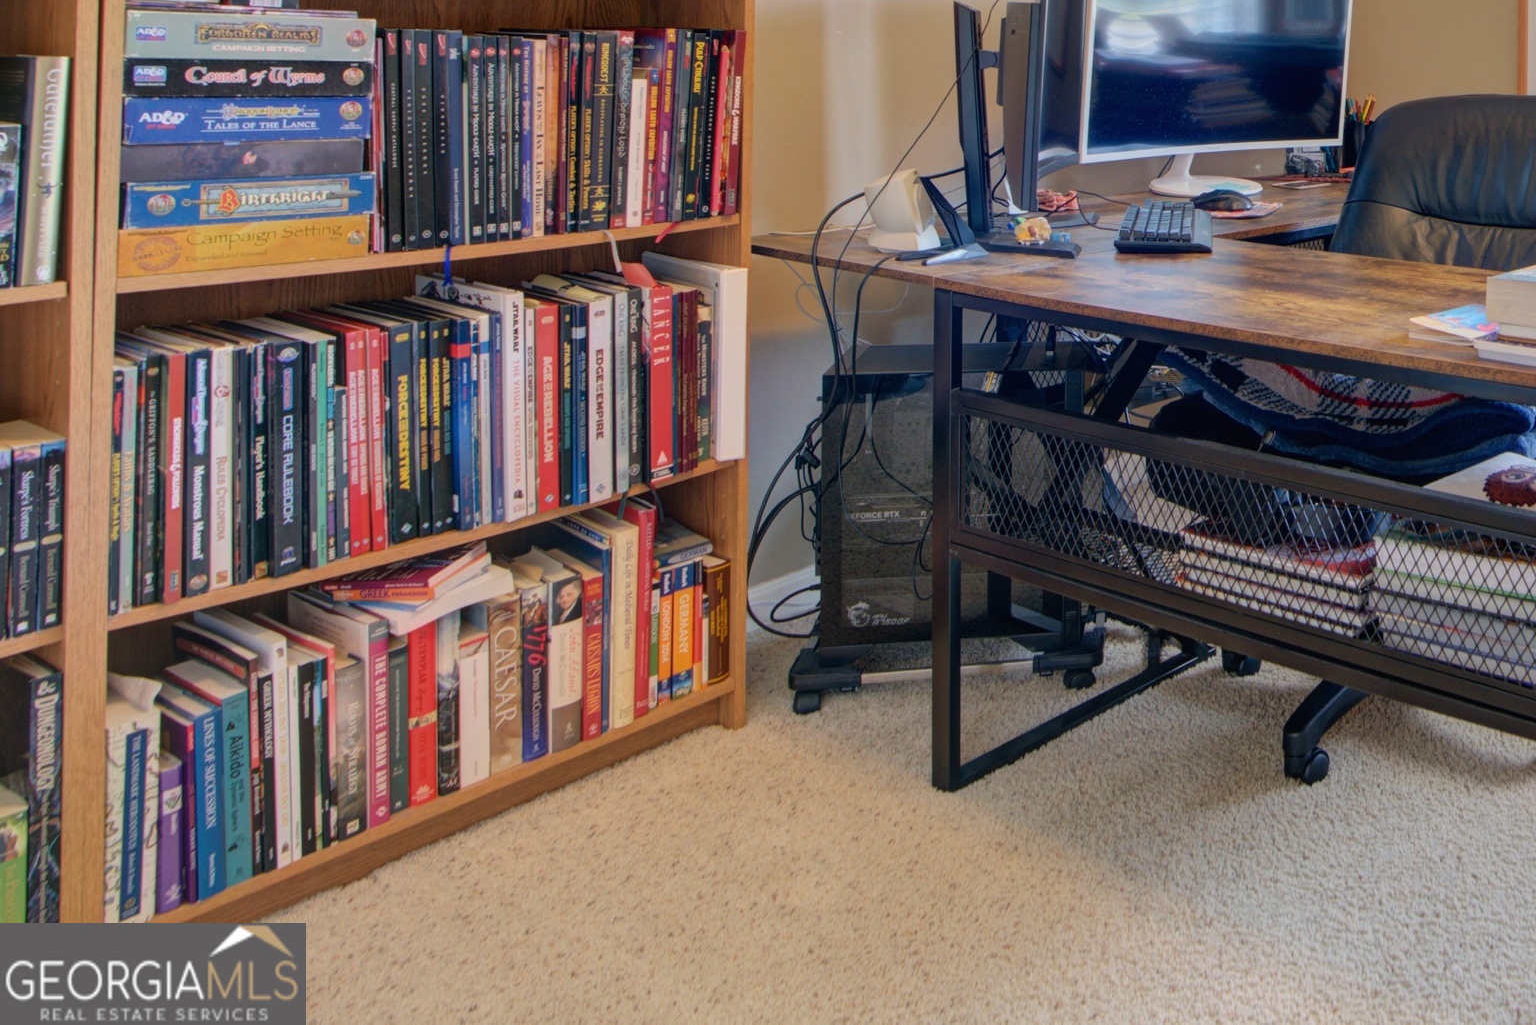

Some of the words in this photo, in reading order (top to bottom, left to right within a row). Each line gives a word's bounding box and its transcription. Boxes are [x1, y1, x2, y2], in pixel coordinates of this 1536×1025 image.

[136, 27, 165, 38] AD&D
[200, 24, 268, 45] FORGOTTEN
[271, 28, 320, 45] REALMS
[213, 43, 265, 53] CAMPAIGN
[269, 44, 305, 54] SETTING
[599, 43, 609, 84] RUNEQUEST
[694, 41, 704, 61] PULP
[135, 66, 165, 78] AD&D
[185, 66, 247, 87] Council
[249, 67, 269, 87] of
[268, 67, 326, 86] Wyrms
[535, 85, 545, 120] LEAVES
[733, 76, 742, 110] KINGDOMS
[139, 110, 185, 126] AD&D
[205, 118, 238, 131] TALES
[242, 120, 256, 130] OF
[259, 120, 278, 129] THE
[282, 118, 317, 129] LANCE
[648, 111, 657, 128] EARTH
[731, 117, 740, 146] WARFARE
[647, 128, 657, 162] EXPEDITION
[535, 161, 544, 187] LAST
[583, 159, 591, 178] Skills
[219, 186, 331, 217] BIRTHRIGHT
[534, 188, 545, 218] HOME
[582, 186, 590, 210] Powers
[186, 228, 276, 256] Campaign
[280, 221, 343, 244] Setting
[512, 302, 520, 325] STAR
[652, 295, 671, 367] LANCER
[371, 368, 380, 386] AGE
[419, 358, 428, 387] FORCE
[442, 357, 450, 380] STAR
[542, 355, 553, 383] AGE
[596, 348, 605, 383] EDGE
[700, 344, 708, 377] MONSTERS
[397, 375, 409, 420] FORCE
[419, 391, 427, 428] DESTINY
[442, 381, 450, 408] WARS
[513, 381, 521, 412] VISUAL
[147, 398, 157, 444] GRIFFON'S
[282, 414, 294, 450] CORE
[372, 391, 382, 440] REBELLION
[543, 391, 554, 464] REBELLION
[595, 394, 605, 441] EMPIRE
[253, 434, 266, 470] Player's
[398, 434, 410, 492] DESTINY
[513, 415, 522, 485] ENCYCLOPEDIA
[147, 447, 156, 496] SADDLEBAG
[216, 456, 229, 486] RULES
[192, 465, 205, 520] Monstrous
[254, 471, 266, 520] Handbook
[282, 452, 295, 524] RULEBOOK
[215, 487, 229, 542] CYCLOPEDIA
[191, 521, 204, 560] Manual
[622, 539, 635, 562] Daily
[622, 562, 635, 580] Life
[622, 591, 635, 625] Medieval
[660, 600, 671, 641] LONDON
[677, 593, 690, 654] GERMANY
[522, 625, 547, 667] 1776
[623, 626, 634, 650] Times
[650, 614, 659, 645] LONDON
[375, 654, 387, 674] THE
[585, 631, 601, 676] CAESAR'S
[660, 641, 671, 663] 2014
[263, 680, 273, 709] GREEK
[493, 626, 518, 733] CAESAR
[532, 666, 543, 691] DAVID
[374, 679, 388, 729] COMPLETE
[585, 677, 601, 716] LEGION
[203, 716, 216, 747] LINES
[263, 709, 274, 759] MYTHOLOGY
[228, 735, 246, 779] Aikido
[374, 731, 388, 767] ROMAN
[374, 768, 388, 799] ARMY
